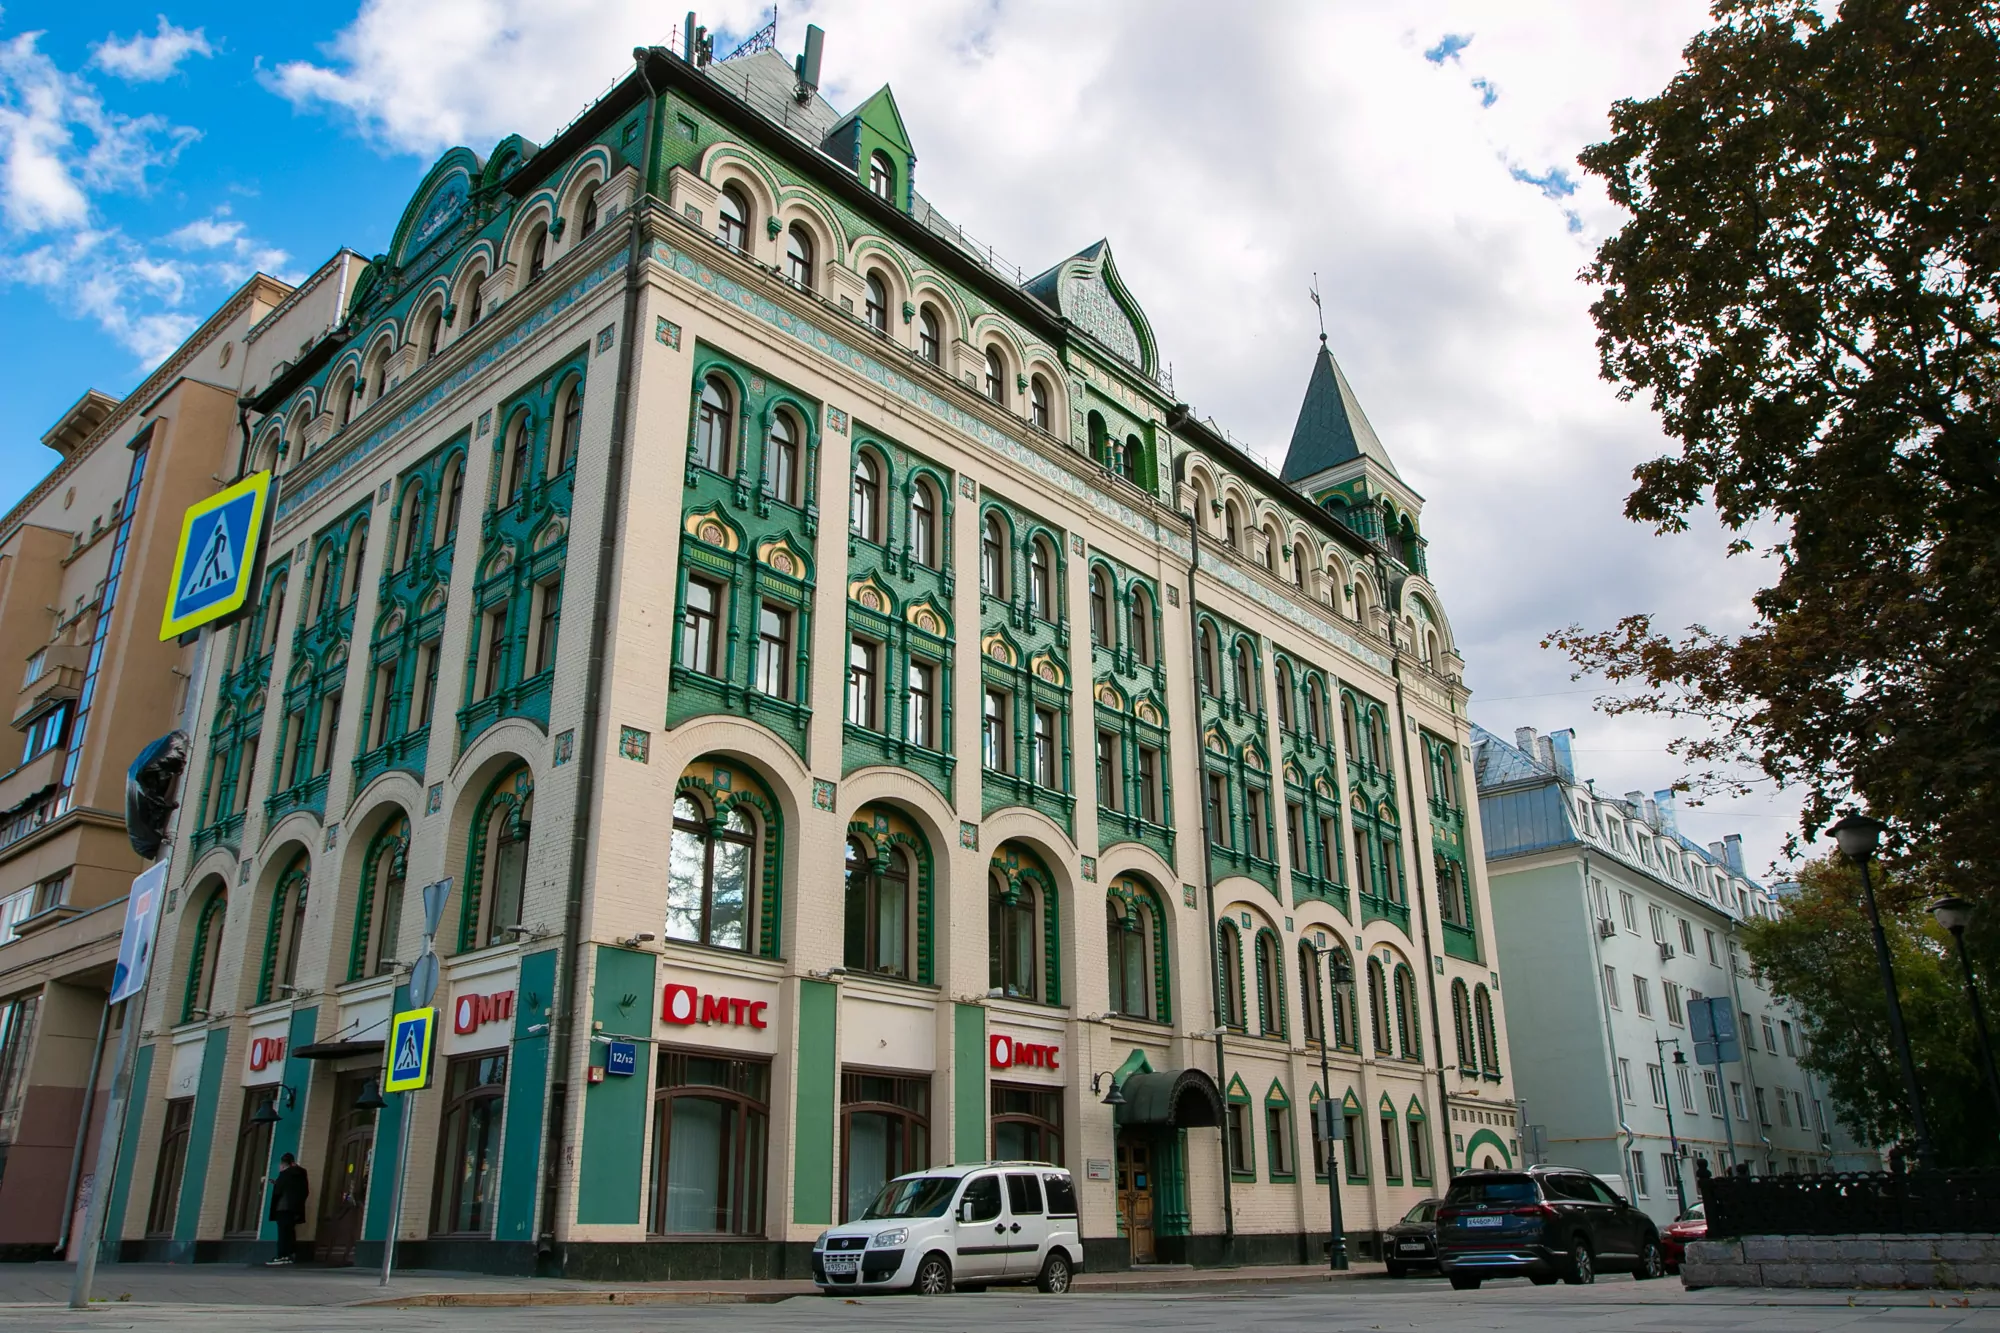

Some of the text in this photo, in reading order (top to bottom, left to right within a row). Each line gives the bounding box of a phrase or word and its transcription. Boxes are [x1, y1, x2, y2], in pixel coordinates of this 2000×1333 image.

[477, 991, 515, 1025] МТ
[702, 994, 768, 1029] МТС
[265, 1036, 287, 1063] МТ
[612, 1052, 634, 1064] 12/12
[1015, 1041, 1060, 1069] МТС
